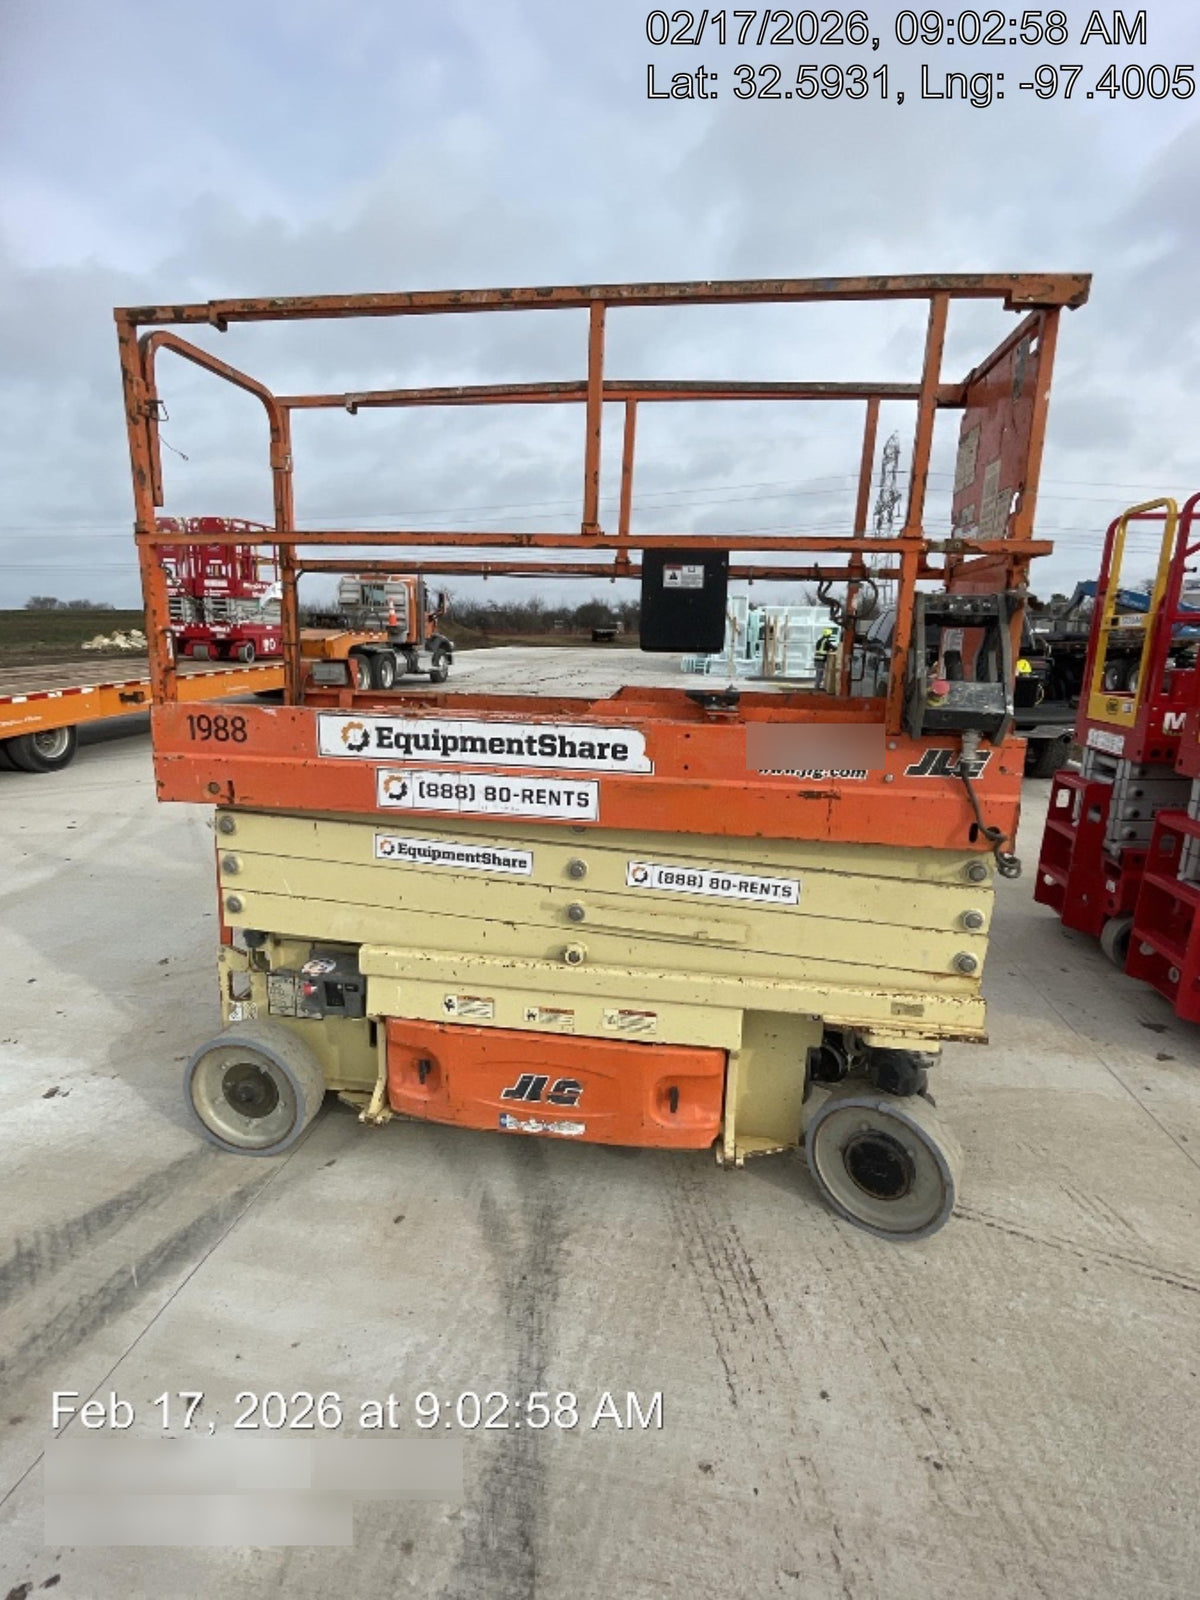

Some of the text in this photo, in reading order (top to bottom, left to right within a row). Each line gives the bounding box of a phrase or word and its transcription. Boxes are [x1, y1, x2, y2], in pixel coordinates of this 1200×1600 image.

[186, 713, 249, 744] 1988
[375, 726, 629, 761] EquipmentShare
[419, 780, 590, 808] (888) 80-RENTS
[397, 842, 528, 870] EquipmentShare
[657, 870, 793, 898] (888) 80-RENTS
